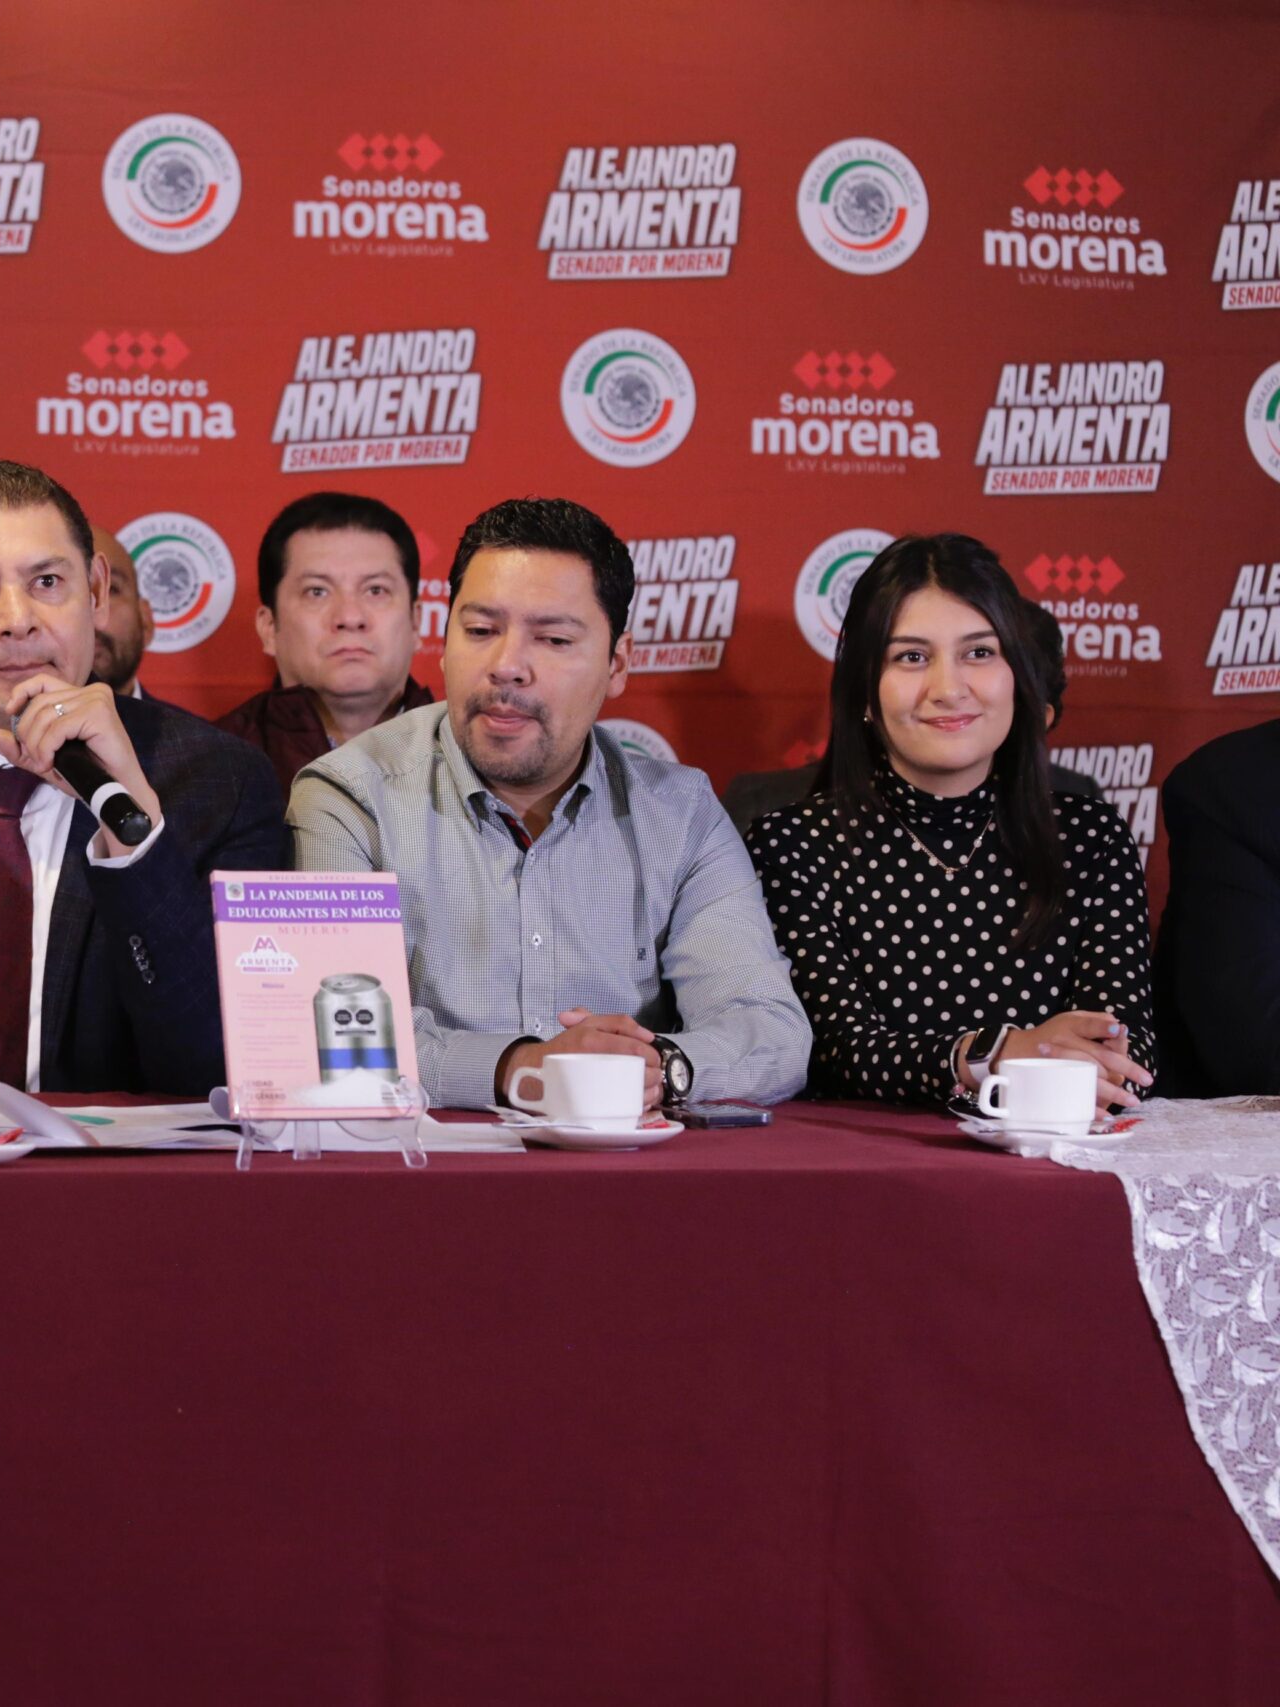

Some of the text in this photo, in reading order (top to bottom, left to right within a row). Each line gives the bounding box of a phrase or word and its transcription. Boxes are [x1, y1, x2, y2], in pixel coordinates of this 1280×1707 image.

[559, 143, 736, 190] ALEJANDRO
[323, 176, 461, 199] Senadores
[293, 201, 489, 242] morena
[538, 187, 741, 250] ARMENTA
[1011, 207, 1140, 234] Senadores
[329, 242, 454, 258] LXV Legislatura
[984, 230, 1167, 275] morena
[555, 253, 724, 275] SENADOR POR MORENA
[1018, 273, 1134, 290] LXV Legislatura
[1229, 286, 1280, 305] SENADO
[294, 328, 476, 381] ALEJANDRO
[67, 372, 208, 397] Senadores
[996, 361, 1164, 406] ALEJANDRO
[272, 373, 481, 443] ARMENTA
[780, 393, 914, 417] Senadores
[1252, 375, 1279, 420] SENADO
[37, 397, 236, 439] morena
[751, 418, 940, 459] morena
[975, 404, 1170, 465] ARMENTA
[72, 440, 199, 457] LXV Legislatura
[289, 440, 461, 467] SENADOR POR MORENA
[784, 460, 906, 475] LXV Legislatura
[991, 467, 1153, 489] SENADOR POR MORENA
[634, 580, 739, 641] ENTA
[1060, 622, 1162, 661] rena
[655, 644, 718, 666] MORENA
[249, 890, 384, 901] LA PANDEMIA DE LOS
[228, 906, 401, 919] EDULCORANTES EN MÉXICO
[277, 926, 350, 935] MUJERES
[240, 957, 294, 966] ARMENTA
